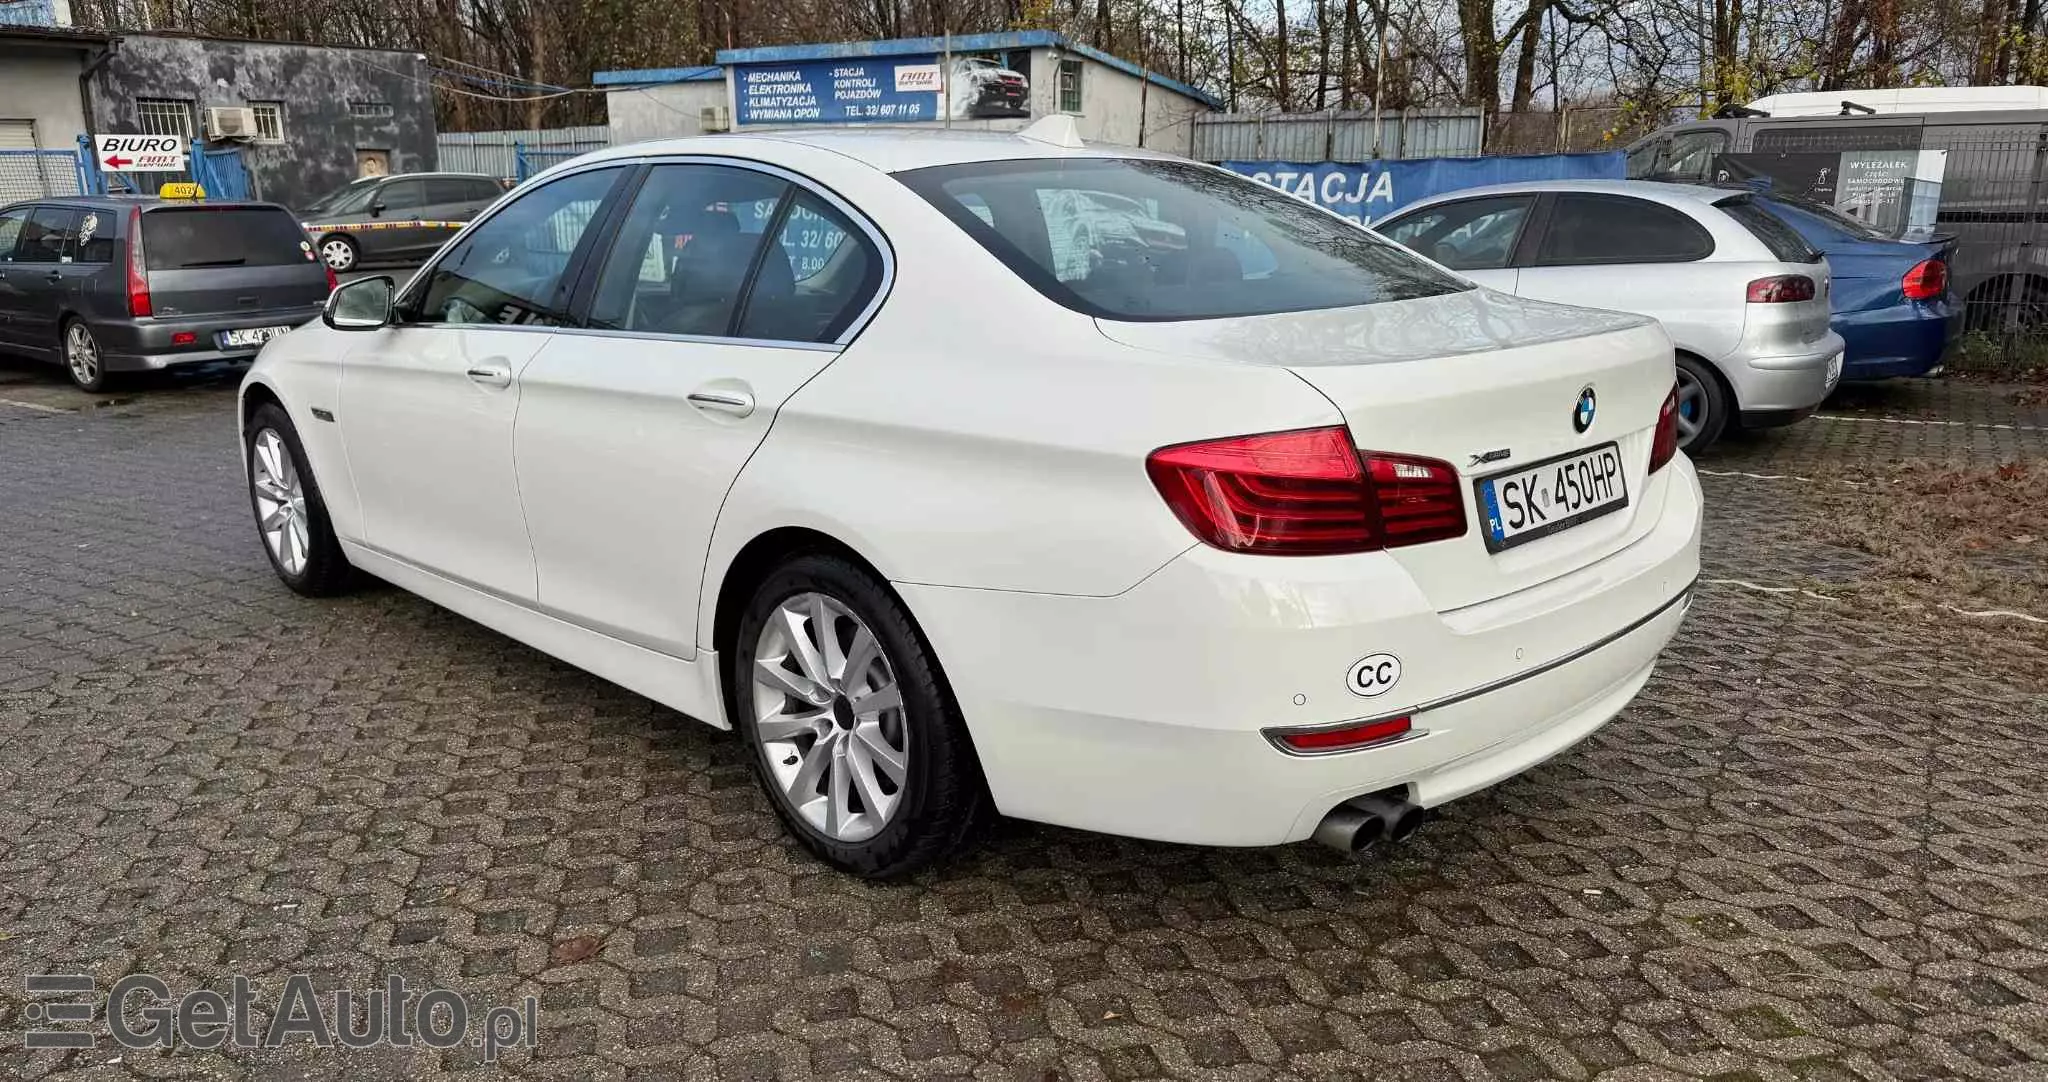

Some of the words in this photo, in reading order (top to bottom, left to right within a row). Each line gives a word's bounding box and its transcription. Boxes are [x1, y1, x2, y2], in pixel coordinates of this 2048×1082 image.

[748, 70, 801, 83] MECHANIKA
[833, 67, 865, 77] STACJA
[748, 82, 812, 95] ELEKTRONIKA
[834, 78, 876, 89] KONTROLI
[834, 88, 882, 100] POJAZDÓW
[749, 95, 817, 107] KLIMATYZACJA
[750, 109, 792, 120] WYMIANA
[793, 107, 821, 119] OPON
[845, 105, 863, 117] TEL.
[880, 104, 896, 115] 607
[898, 104, 907, 115] 11
[909, 103, 921, 114] 05
[102, 138, 177, 152] BIURO
[1503, 474, 1547, 529] SK
[1555, 452, 1616, 513] 450HP
[1490, 519, 1502, 533] PL
[1357, 661, 1392, 688] CC
